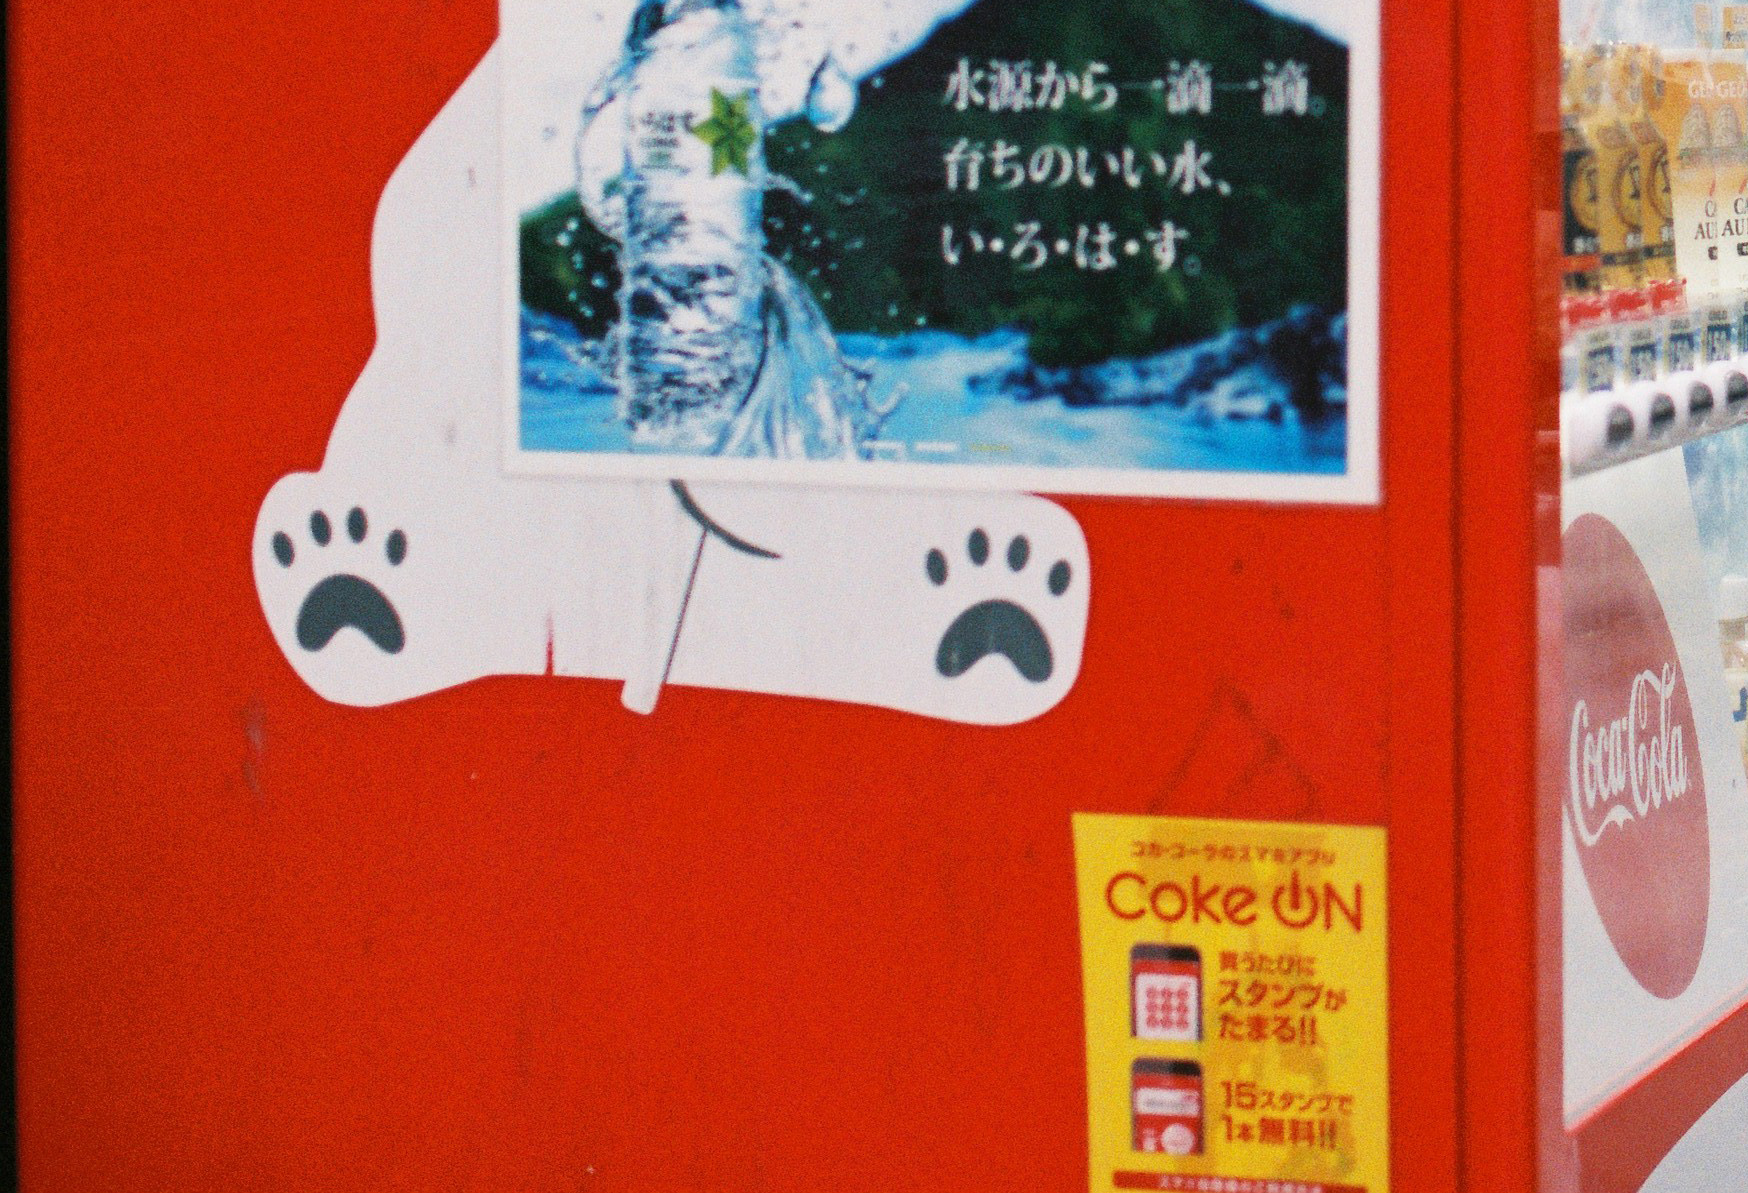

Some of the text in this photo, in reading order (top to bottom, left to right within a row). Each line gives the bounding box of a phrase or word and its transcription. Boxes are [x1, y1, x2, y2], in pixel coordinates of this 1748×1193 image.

[1569, 659, 1688, 847] Coca-Cola
[1105, 870, 1364, 934] Coke ON
